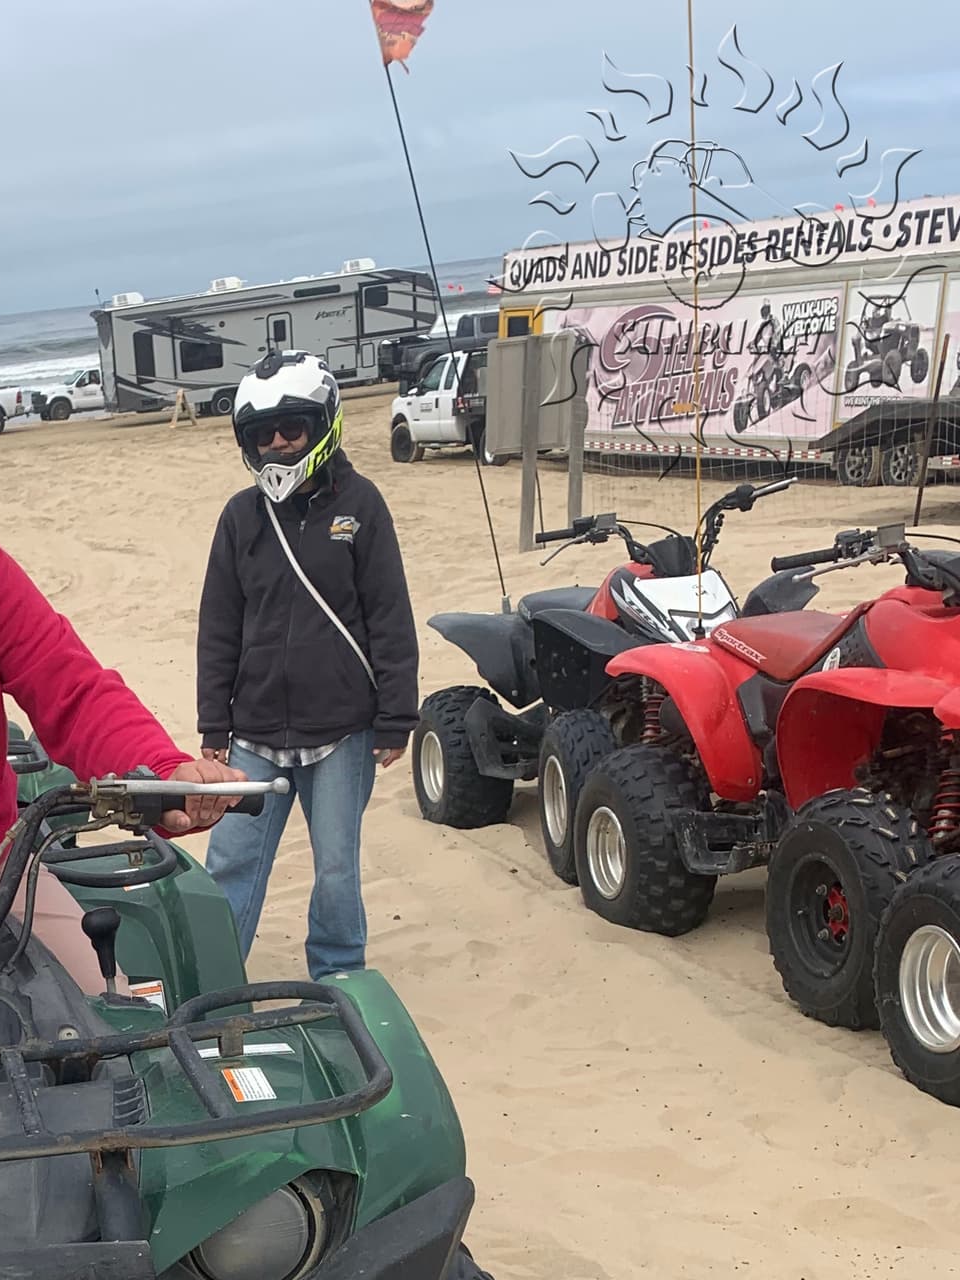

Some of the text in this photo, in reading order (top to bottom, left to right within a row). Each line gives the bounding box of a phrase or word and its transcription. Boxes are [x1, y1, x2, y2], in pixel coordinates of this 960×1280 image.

[510, 254, 568, 288] QUADS
[571, 249, 612, 280] AND
[617, 244, 660, 276] SIDE
[666, 240, 693, 271] BY
[698, 231, 757, 268] SIDES
[766, 217, 874, 261] RENTALS
[783, 297, 838, 321] WALK-UPS
[649, 367, 739, 422] RENTALS
[715, 628, 765, 663] Sportrax
